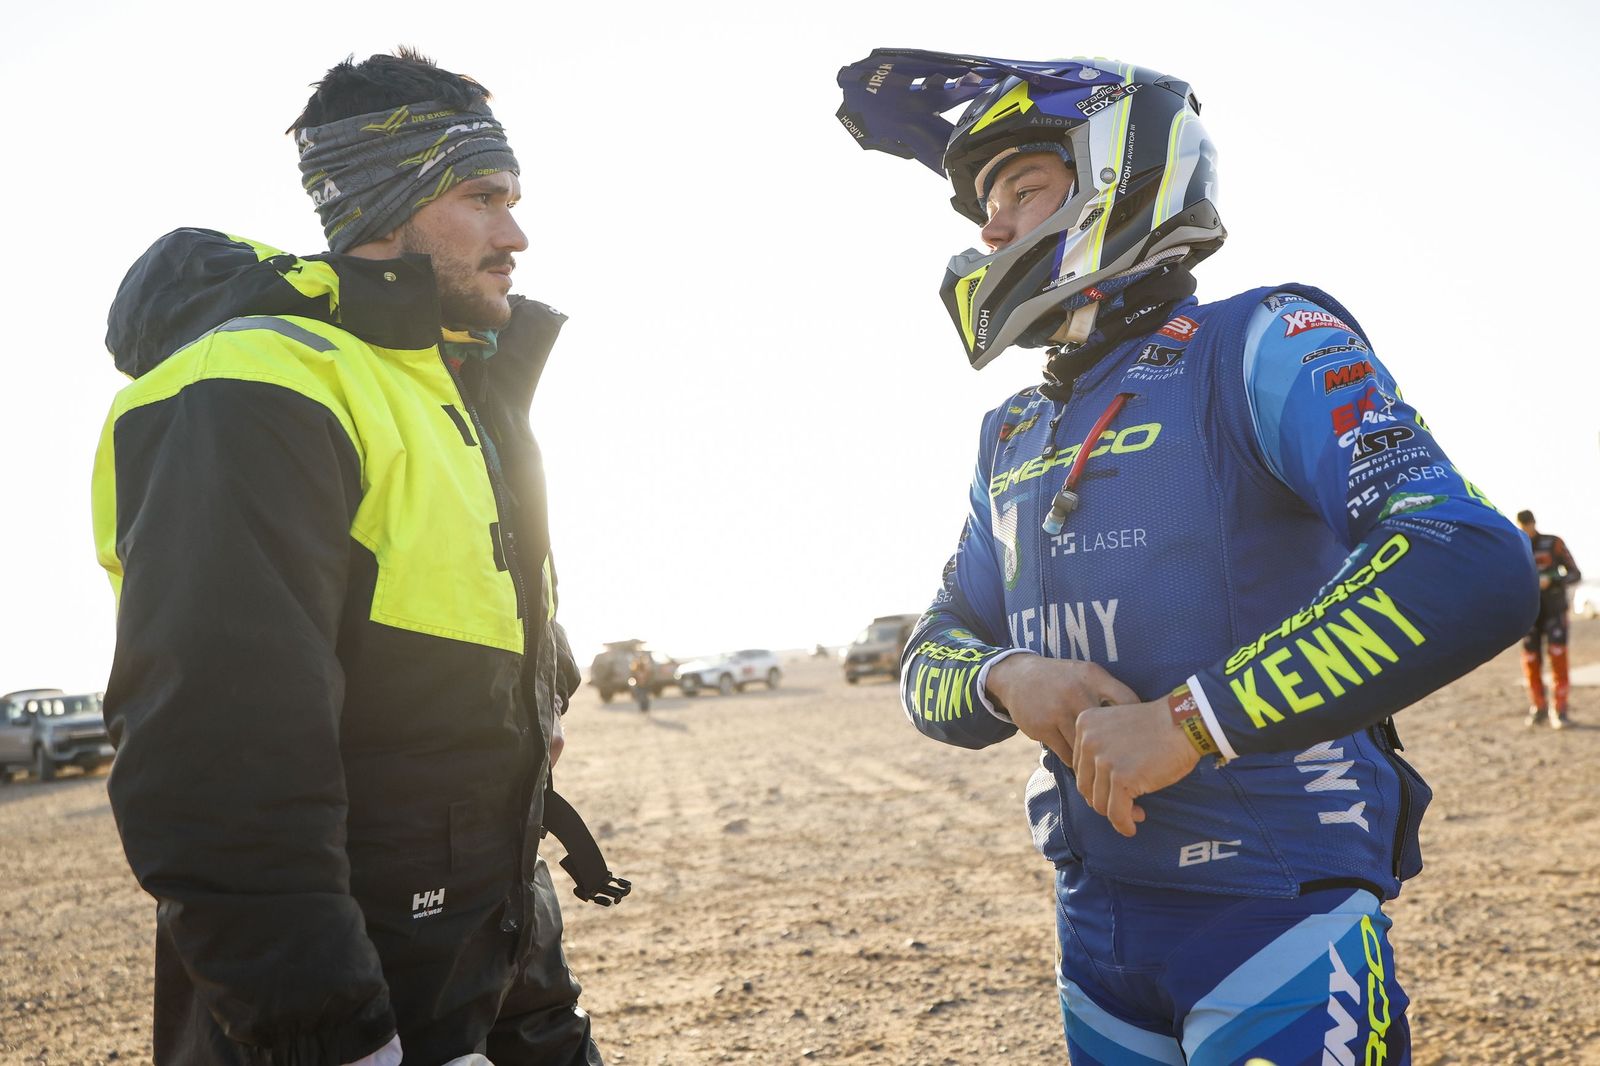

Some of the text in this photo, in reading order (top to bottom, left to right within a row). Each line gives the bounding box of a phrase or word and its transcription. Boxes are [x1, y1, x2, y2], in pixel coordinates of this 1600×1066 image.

[1076, 84, 1120, 109] Bradley
[1083, 97, 1114, 117] COX
[840, 115, 864, 139] AIROH
[1031, 117, 1072, 126] AIROH
[1118, 165, 1132, 194] AIROH
[1127, 130, 1136, 159] AVIATOR
[977, 309, 990, 350] AIROH
[1384, 465, 1448, 491] LASER
[1083, 528, 1147, 552] LASER
[1224, 533, 1410, 675] SHERCO
[1008, 599, 1119, 662] KENNY
[1229, 587, 1426, 729] KENNY
[1179, 839, 1242, 868] BC
[412, 888, 446, 911] HH
